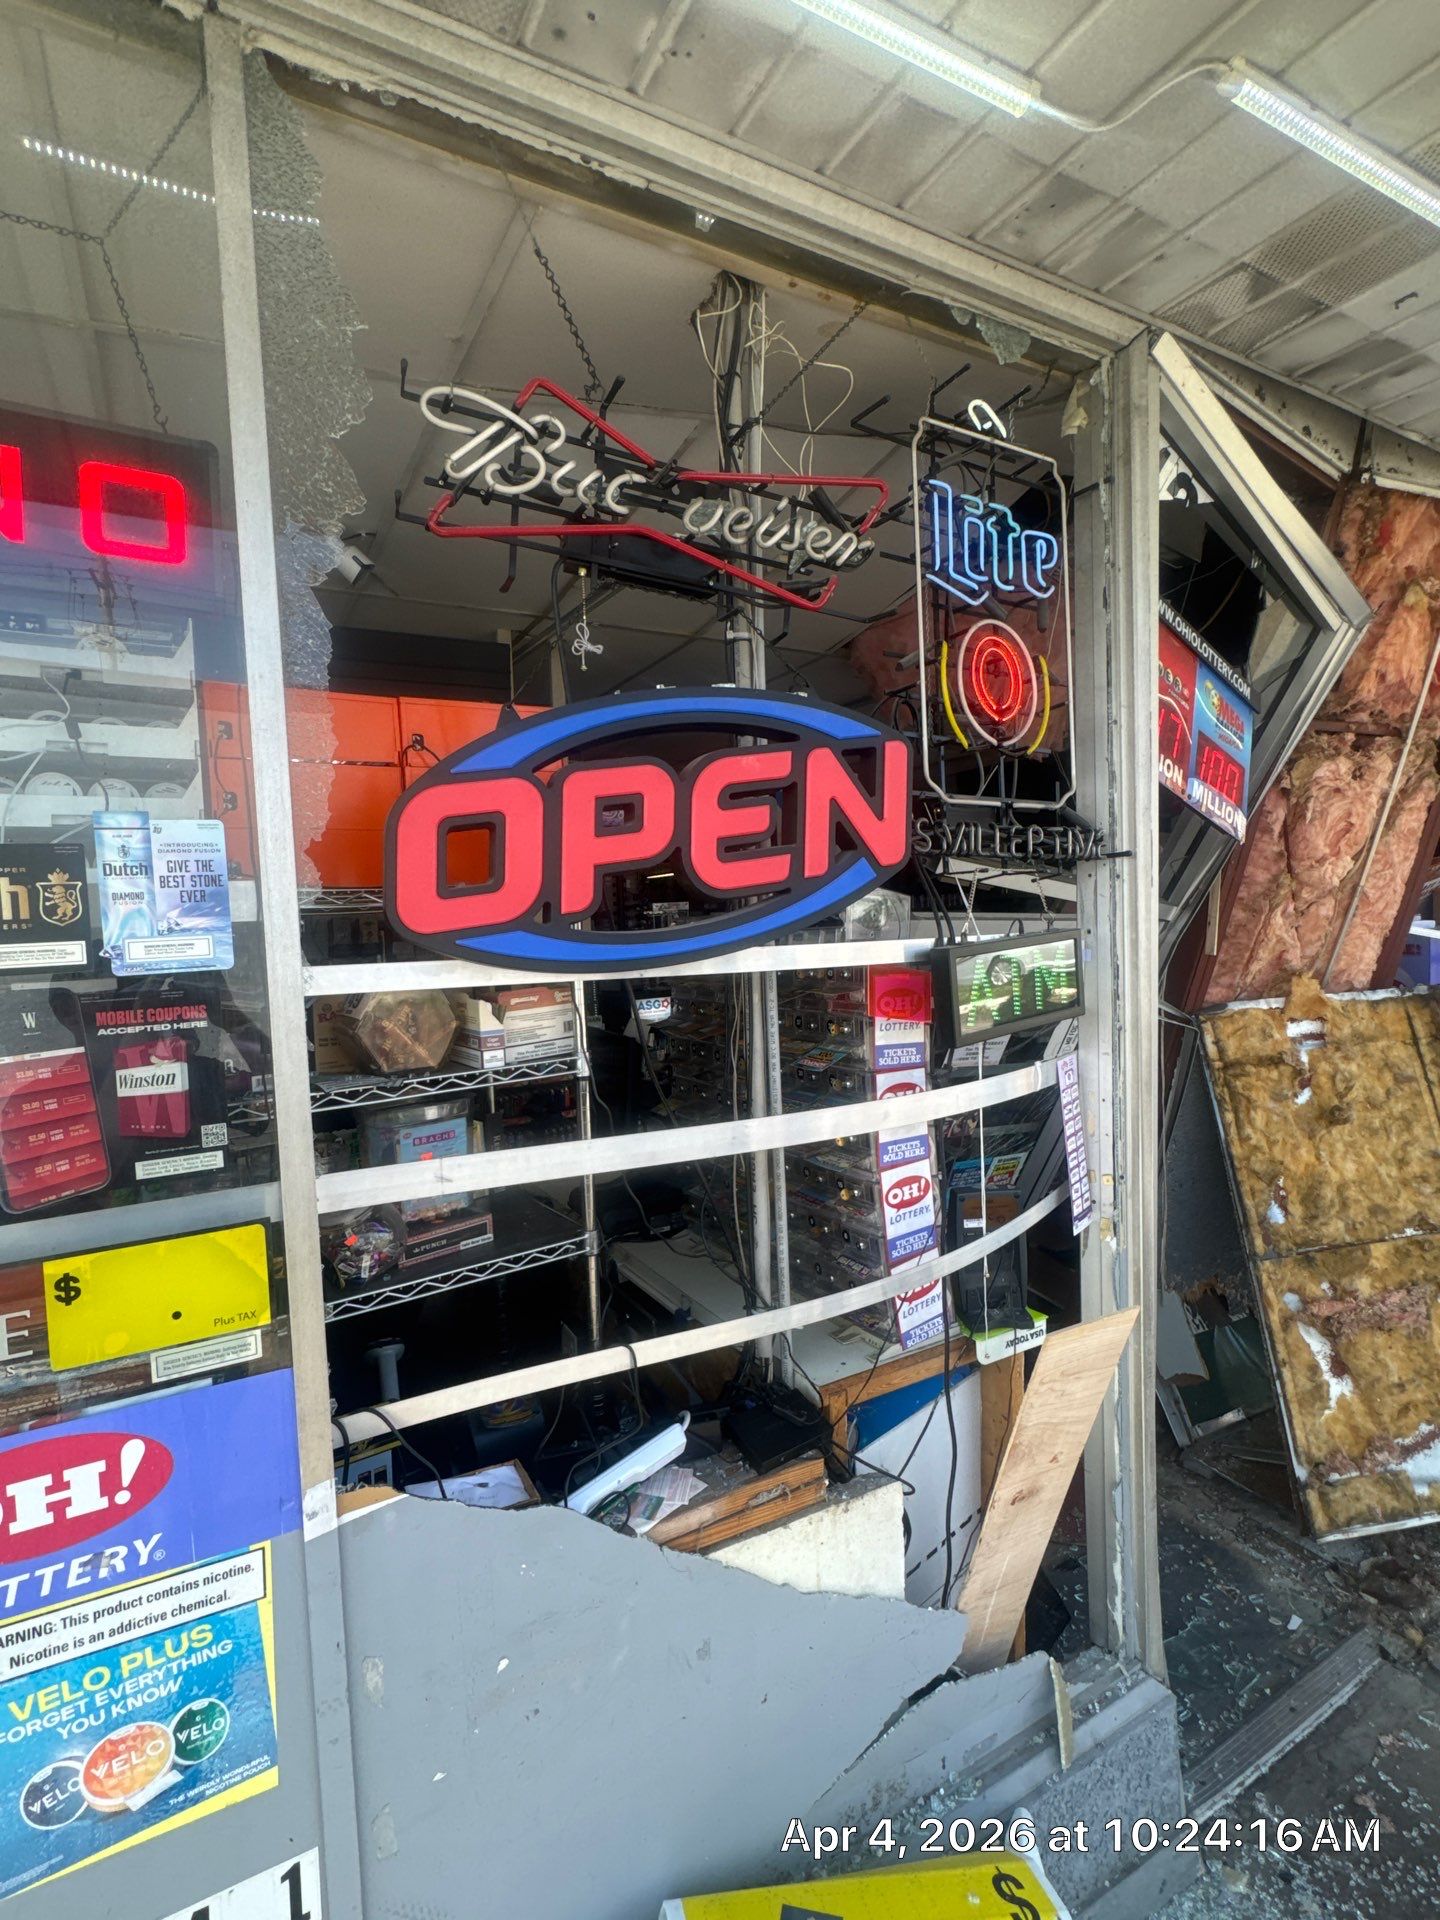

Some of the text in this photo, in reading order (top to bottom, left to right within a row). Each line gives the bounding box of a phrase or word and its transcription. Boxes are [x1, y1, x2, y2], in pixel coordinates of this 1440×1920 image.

[925, 479, 1058, 605] Lite
[1192, 780, 1246, 829] MILLION
[397, 740, 908, 935] OPEN
[102, 862, 149, 877] Dutch
[166, 859, 215, 873] GIVE THE
[159, 874, 224, 889] BEST STONE
[111, 891, 145, 901] DIAMOND
[179, 890, 207, 903] EVER
[21, 1012, 37, 1029] W
[95, 1005, 208, 1026] MOBILE COUPONS
[97, 1020, 208, 1036] ACCEPTED HERE
[879, 1021, 919, 1032] LOTTERY
[878, 1054, 922, 1066] SOLD HERE
[883, 1047, 917, 1057] TICKETS
[118, 1072, 176, 1089] Winston
[883, 1146, 926, 1163] SOLD HERE
[887, 1140, 921, 1154] TICKETS
[887, 1177, 926, 1204] OH!
[889, 1204, 931, 1226] LOTTERY
[420, 1239, 447, 1252] PUNCH
[895, 1231, 929, 1248] TICKETS
[891, 1244, 912, 1259] SOLD
[54, 1272, 82, 1307] $
[902, 1292, 941, 1319] LOTTERY
[213, 1310, 257, 1327] Plus TAX
[909, 1317, 943, 1338] TICKETS
[906, 1332, 928, 1348] SOLD
[1005, 1329, 1044, 1349] USA TODAY
[0, 1438, 146, 1536] H!
[60, 1608, 89, 1630] This
[93, 1595, 143, 1623] product
[146, 1581, 200, 1604] contains
[202, 1562, 255, 1587] nicotine.
[9, 1590, 231, 1670] Nicotine is an addictive chemical.
[8, 1624, 215, 1722] VELO PLUS
[95, 1639, 233, 1706] EVERYTHING
[56, 1675, 183, 1740] YOU KNOW
[177, 1717, 225, 1744] VELO
[91, 1738, 166, 1780] VELO
[168, 1754, 271, 1806] THE WEIRDLY WONDERFUL
[205, 1760, 271, 1796] NICOTINE POUCH
[28, 1777, 80, 1815] VELO
